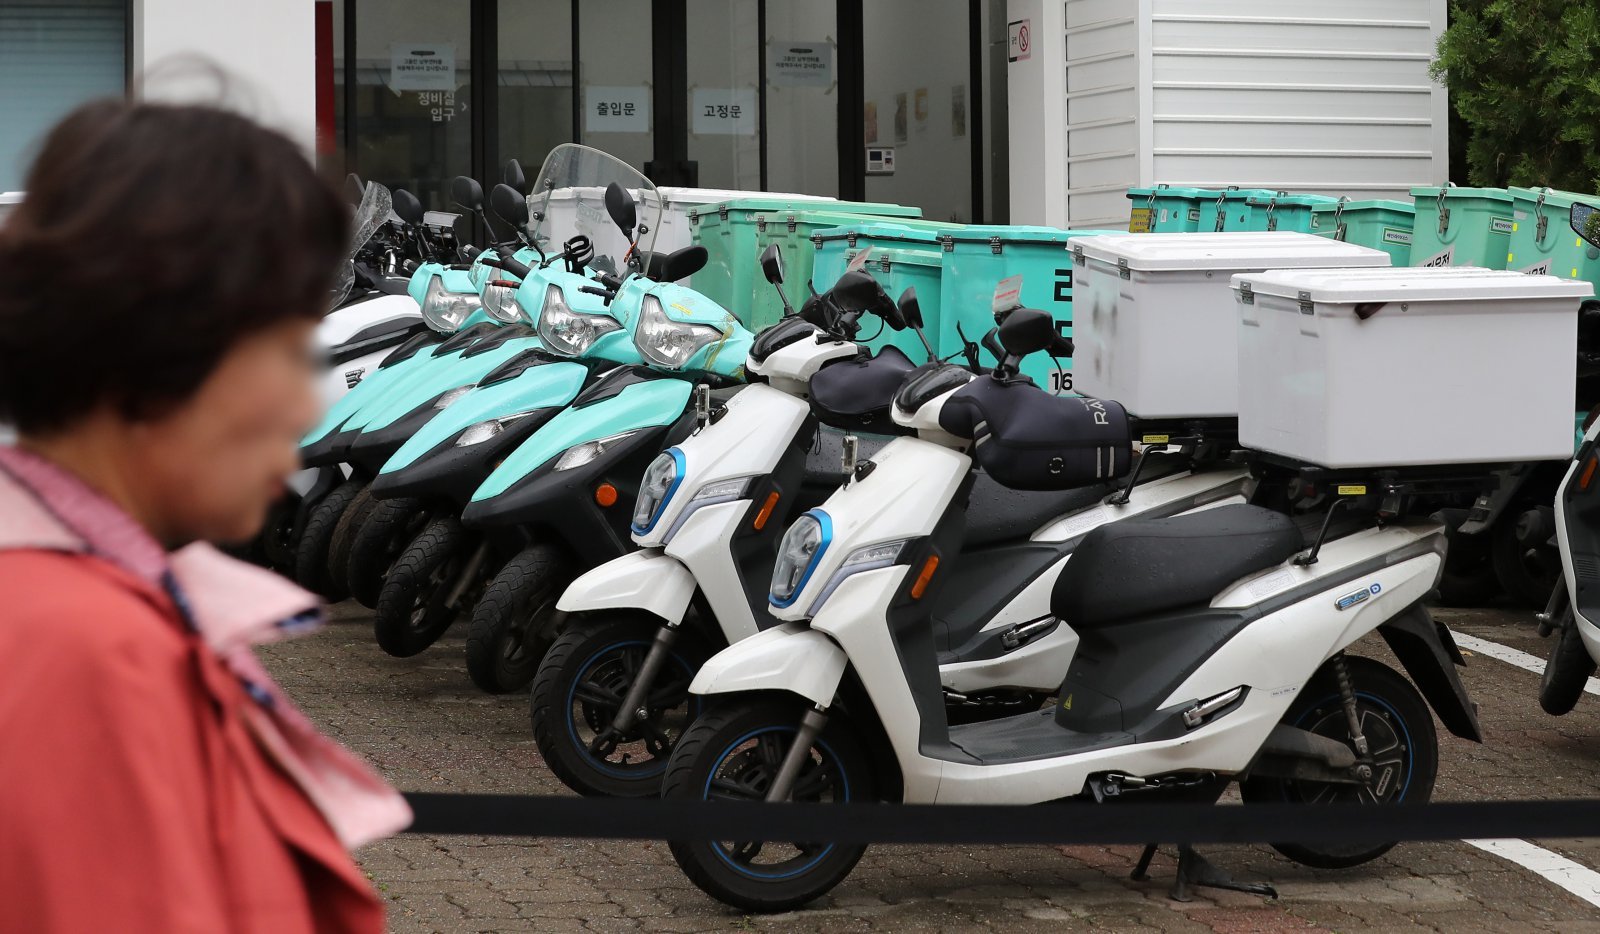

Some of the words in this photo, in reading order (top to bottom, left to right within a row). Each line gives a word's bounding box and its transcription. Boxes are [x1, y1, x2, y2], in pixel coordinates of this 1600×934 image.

[418, 92, 455, 106] 정비실
[431, 107, 456, 121] 입구
[597, 102, 636, 116] 출입문
[703, 105, 742, 119] 고정문
